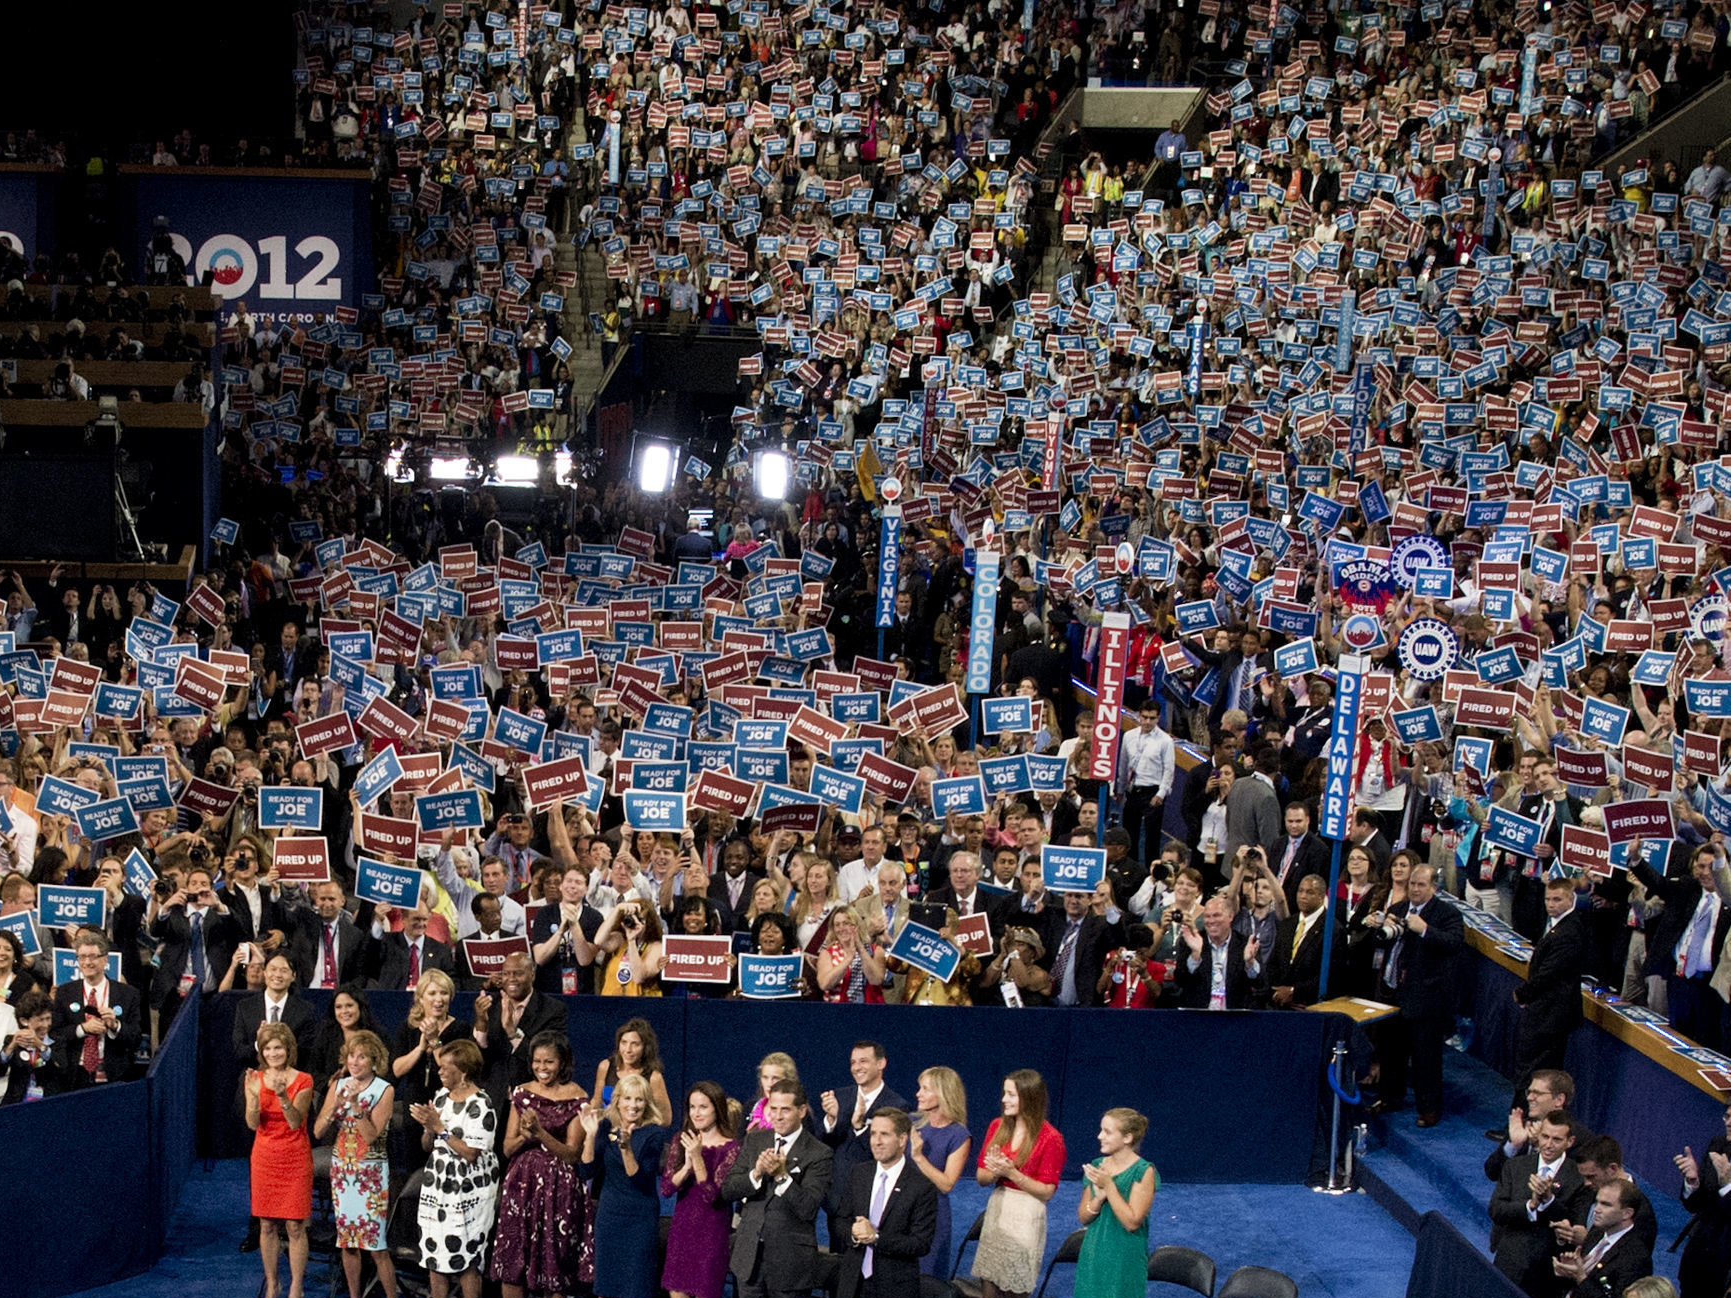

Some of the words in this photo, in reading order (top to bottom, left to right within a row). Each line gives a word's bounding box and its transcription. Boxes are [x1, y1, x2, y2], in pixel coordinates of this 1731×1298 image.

[1190, 326, 1201, 391] TEXAS
[1353, 366, 1367, 451] FLORIDA
[1043, 423, 1057, 491] WYOMI
[1406, 557, 1429, 568] UAW
[879, 520, 897, 625] VIRGINIA
[1341, 562, 1390, 582] OBAMA
[972, 568, 996, 690] COLORADO
[1610, 632, 1634, 640] FIRED
[1415, 643, 1439, 657] UAW
[1094, 630, 1120, 778] ILLINOIS
[1462, 703, 1493, 713] FIRED
[1495, 706, 1509, 715] UP
[997, 711, 1021, 723] JOE
[304, 731, 332, 746] FIRED
[333, 726, 347, 736] UP
[1326, 675, 1355, 836] DELAWARE
[531, 775, 564, 791] FIRED
[565, 771, 580, 782] UP
[702, 784, 731, 800] FIRED
[733, 794, 747, 805] UP
[276, 804, 306, 816] JOE
[1612, 816, 1648, 829] FIRED
[1651, 816, 1666, 825] UP
[277, 856, 305, 865] FIRED
[307, 855, 323, 865] UP
[1050, 856, 1077, 864] READY
[1079, 857, 1096, 866] FOR
[366, 869, 392, 881] READY
[395, 875, 412, 884] FOR
[1055, 865, 1087, 878] JOE
[372, 880, 402, 896] JOE
[48, 895, 75, 903] READY
[55, 905, 87, 918] JOE
[473, 955, 506, 964] FIRED
[670, 954, 704, 964] FIRED
[708, 956, 724, 965] UP
[748, 964, 776, 972] READY
[778, 964, 794, 972] FOR
[756, 973, 786, 986] JOE
